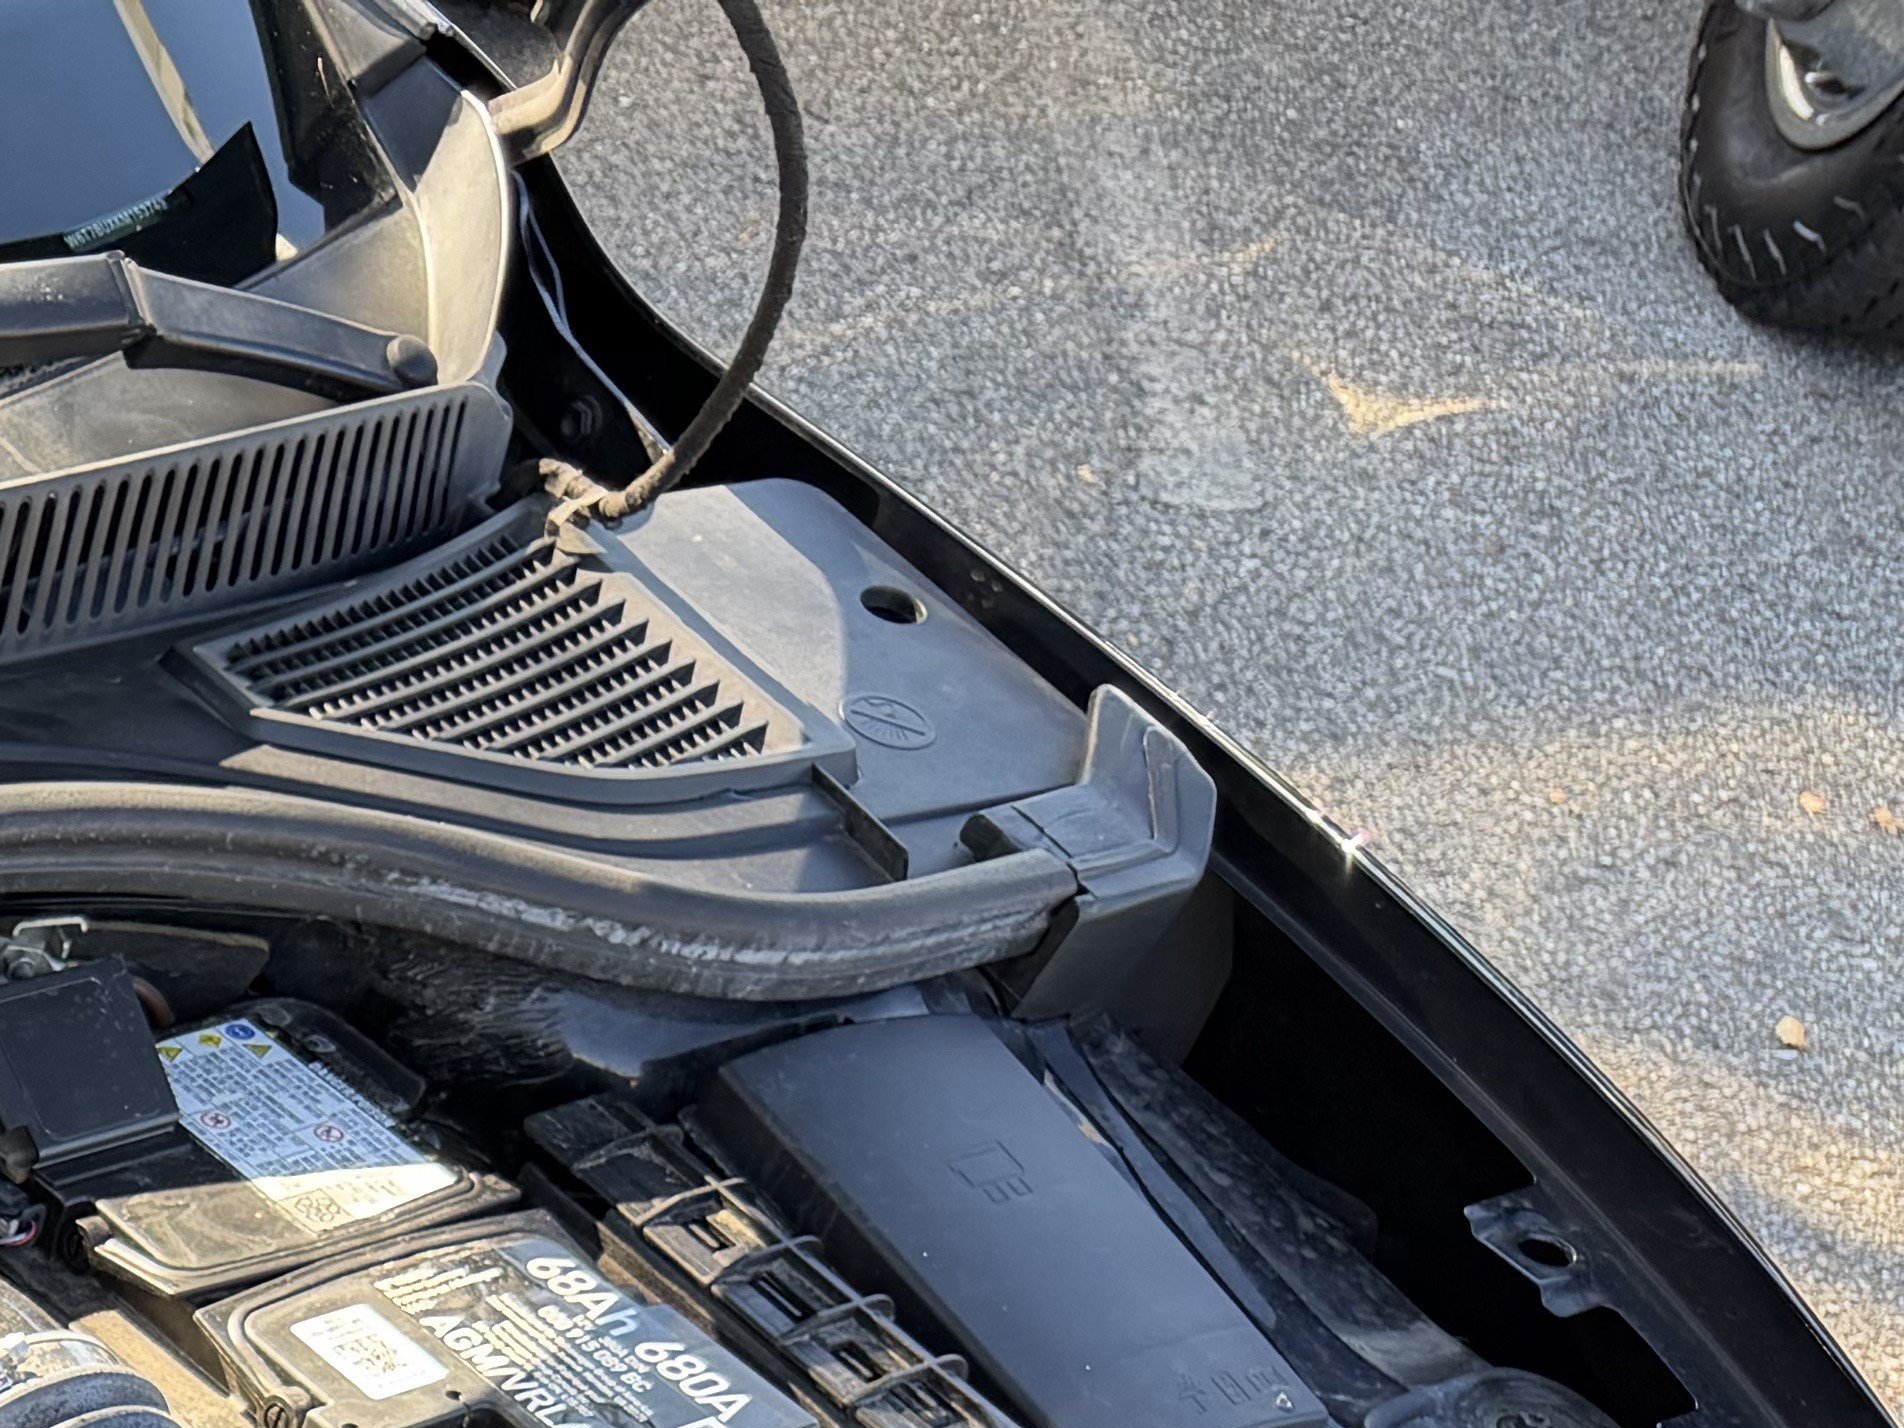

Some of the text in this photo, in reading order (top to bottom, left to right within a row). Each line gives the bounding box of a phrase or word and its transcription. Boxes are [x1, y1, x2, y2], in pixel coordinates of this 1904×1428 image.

[526, 1257, 641, 1337] 68Ah
[634, 1341, 753, 1423] 680A
[565, 1328, 597, 1355] 915
